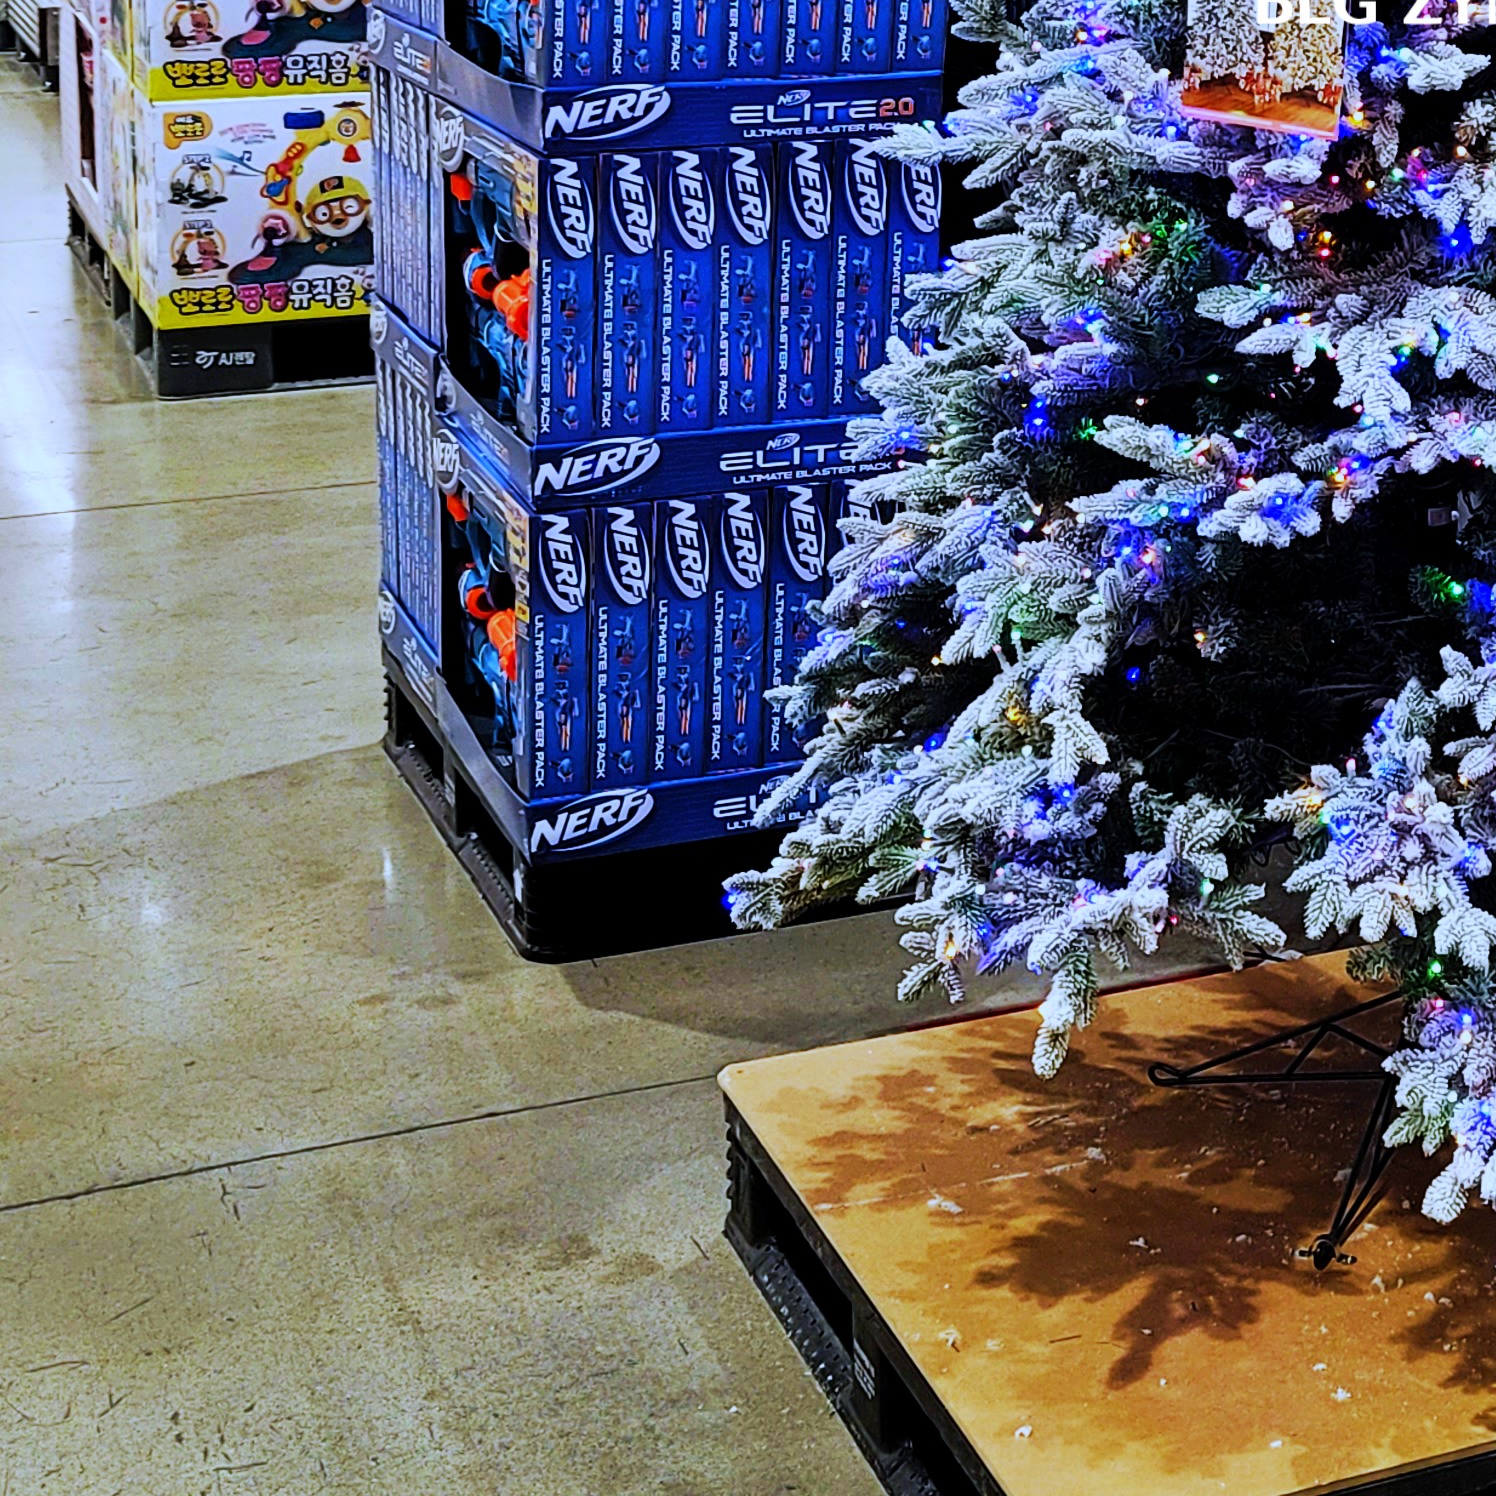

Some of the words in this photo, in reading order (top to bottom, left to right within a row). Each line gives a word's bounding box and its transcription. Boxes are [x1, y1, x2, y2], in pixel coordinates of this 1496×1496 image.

[283, 51, 349, 85] 뮤직홈
[553, 41, 563, 78] PACK
[545, 86, 665, 140] NERF
[743, 127, 802, 138] ULTIMATE
[805, 124, 865, 135] BLASTER
[553, 159, 592, 259] NERF
[289, 275, 355, 309] 뮤직홈
[534, 438, 656, 496] NERF
[732, 471, 793, 484] ULTIMATE
[796, 466, 856, 479] BLASTER
[859, 461, 892, 473] PACK
[544, 515, 583, 612] NERF
[531, 791, 650, 849] NERF
